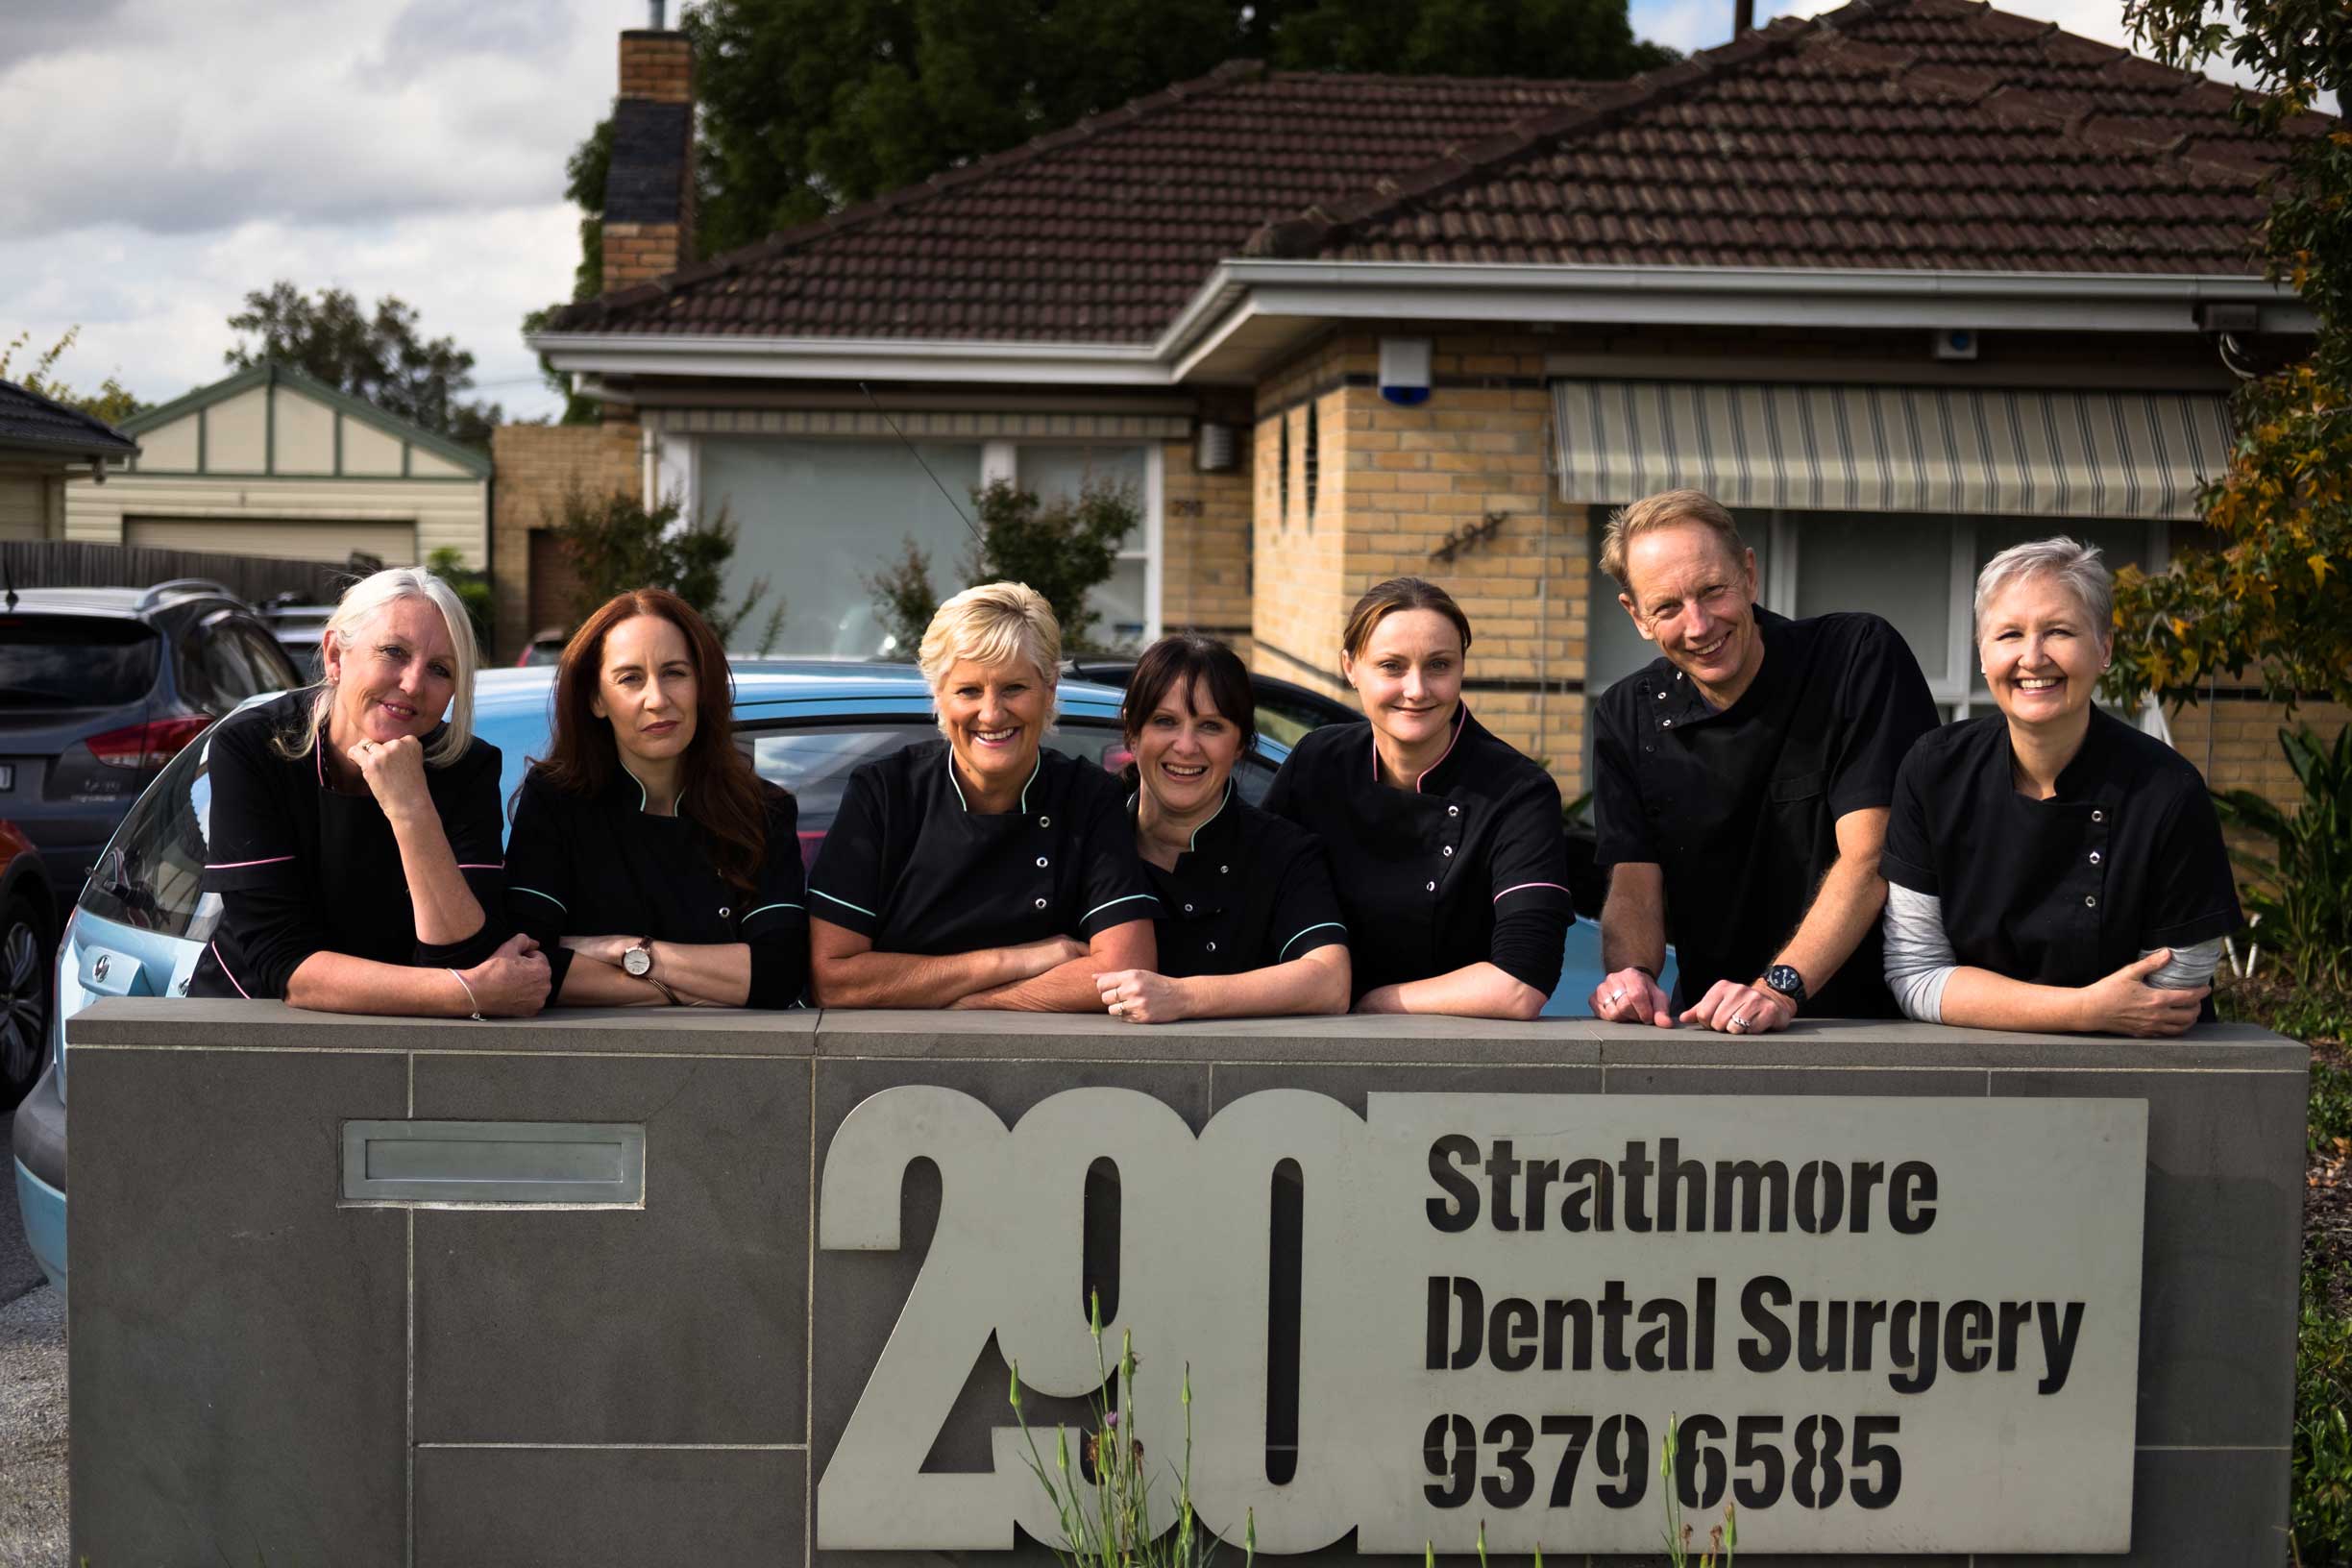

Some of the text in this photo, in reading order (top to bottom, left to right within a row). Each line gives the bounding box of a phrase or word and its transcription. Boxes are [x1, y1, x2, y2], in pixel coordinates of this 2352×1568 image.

[1425, 1133, 1939, 1236] Strathmore
[817, 1085, 1366, 1555] 290
[1425, 1274, 2087, 1396] Dental Surgery
[1422, 1412, 1903, 1510] 9379 6585
